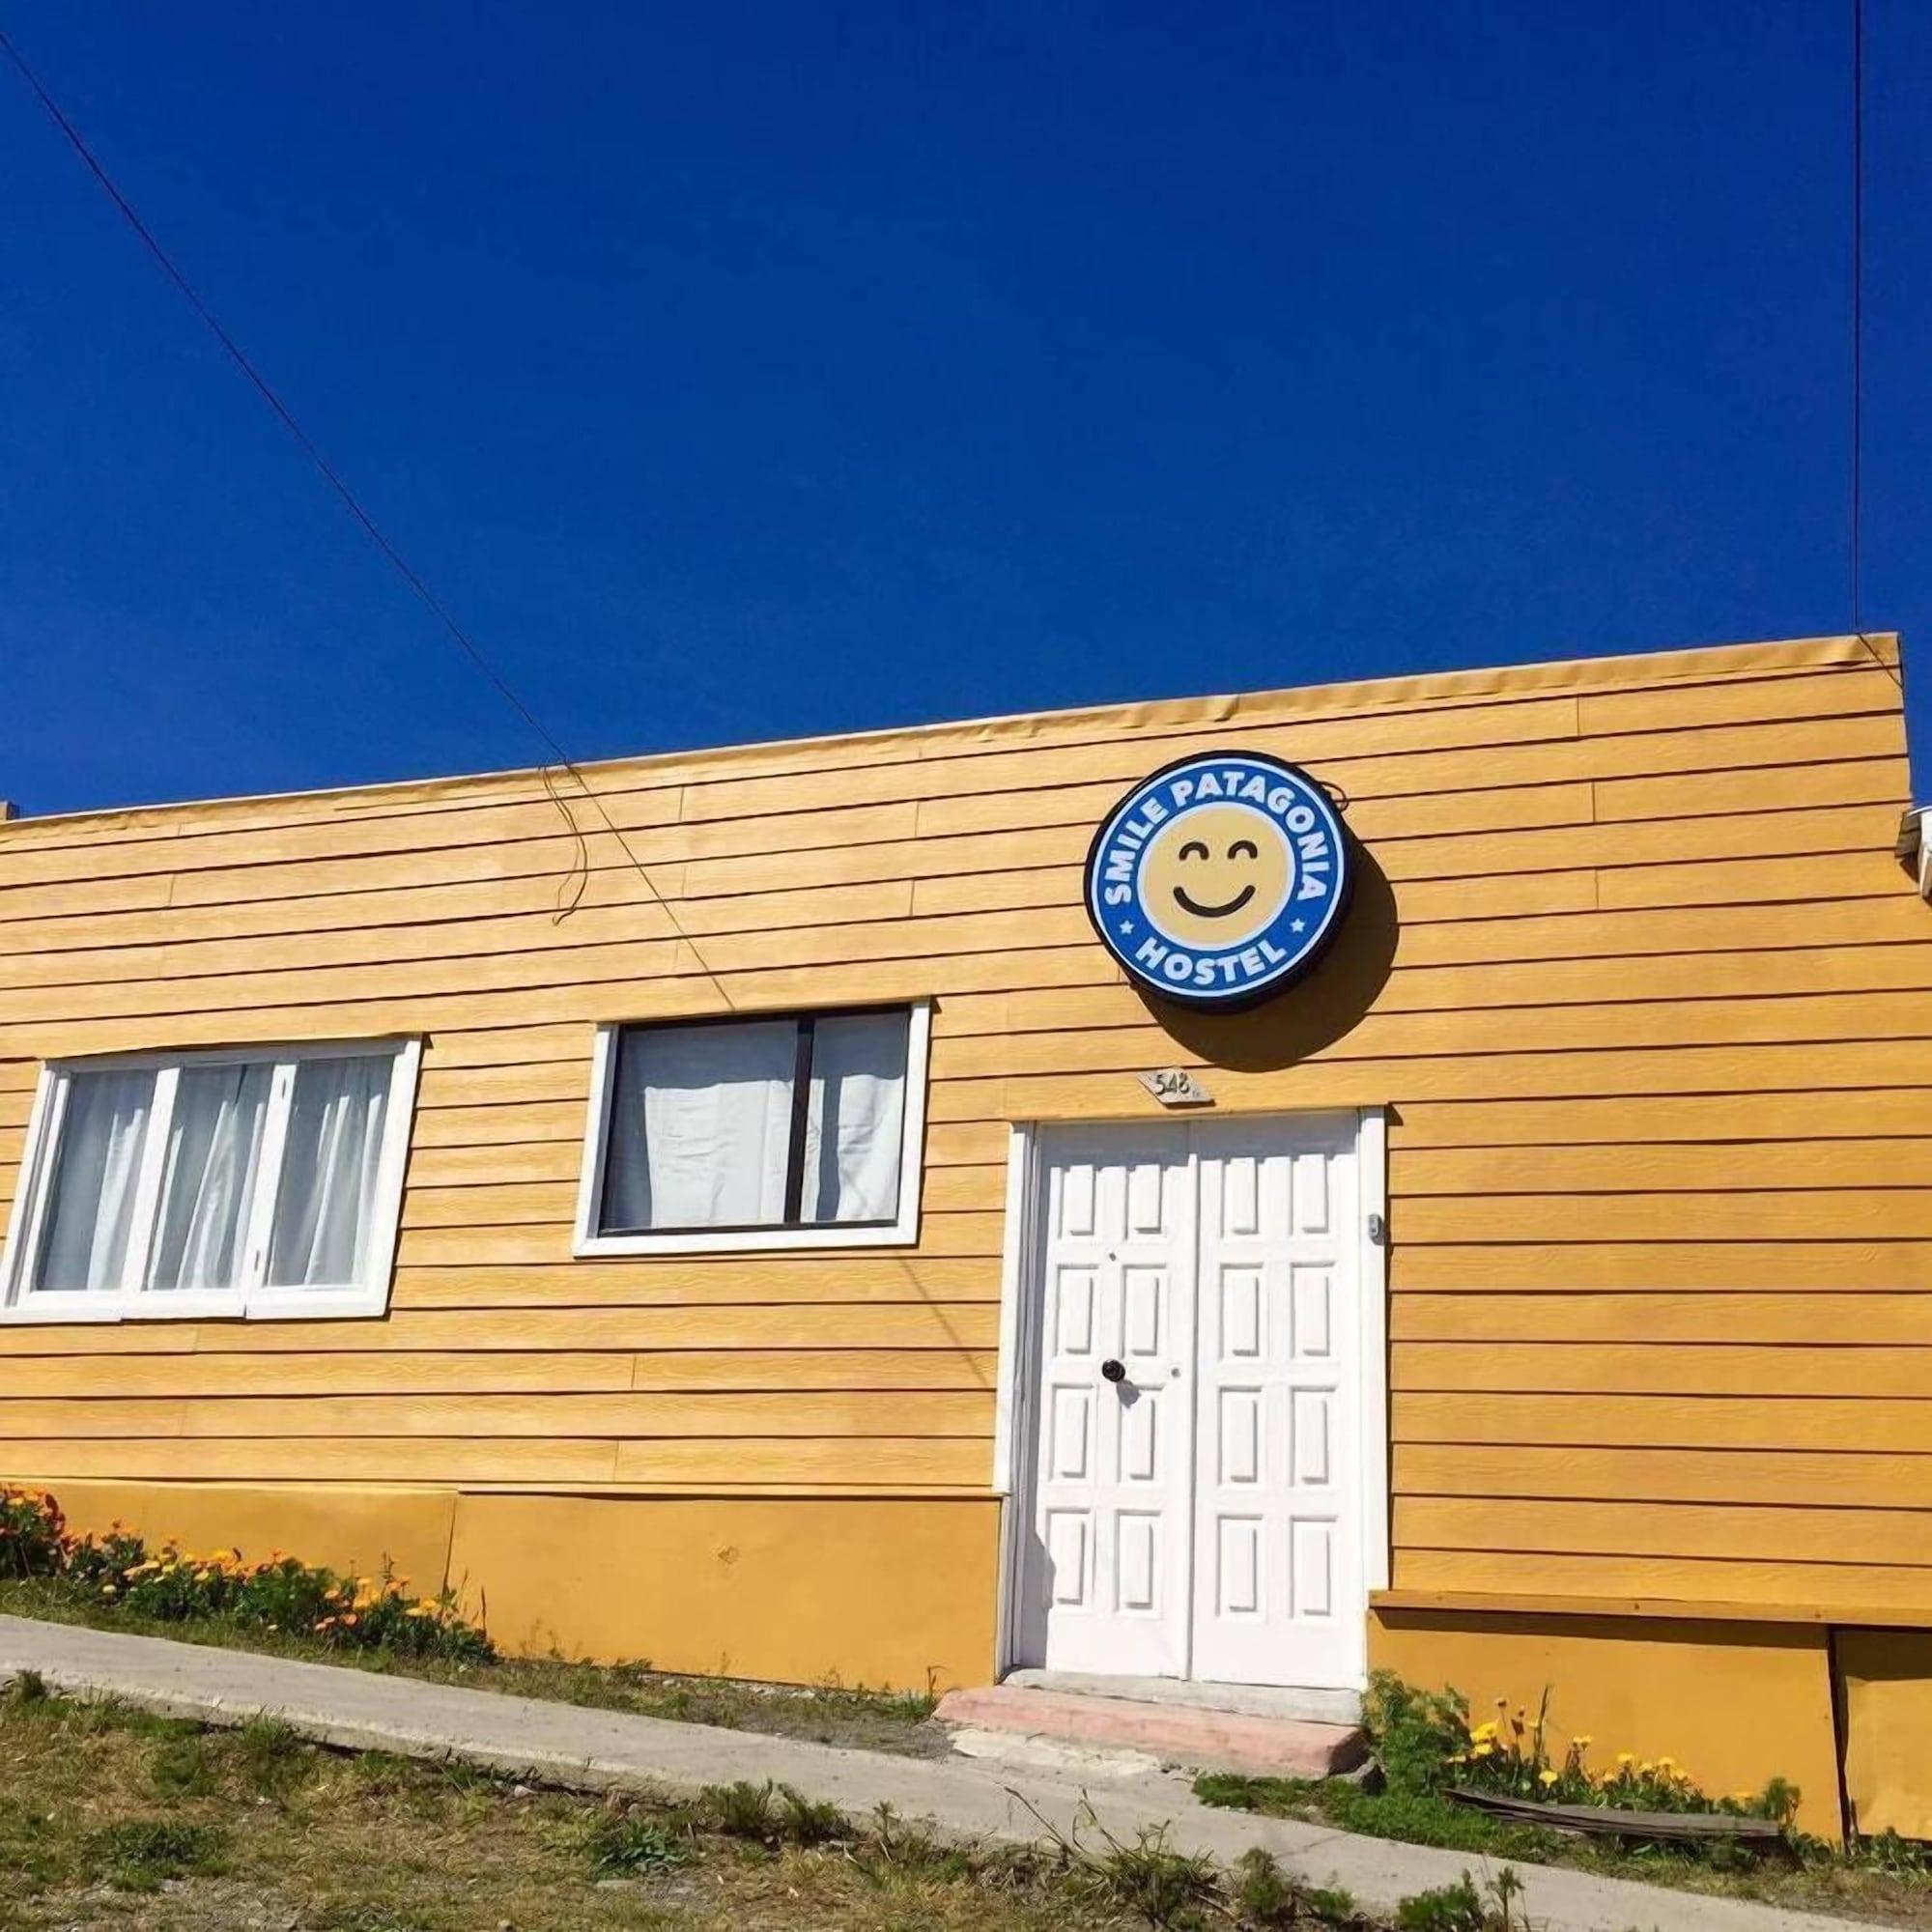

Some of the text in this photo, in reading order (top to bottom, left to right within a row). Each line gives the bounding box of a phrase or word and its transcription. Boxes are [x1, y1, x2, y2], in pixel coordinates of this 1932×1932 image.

[1104, 771, 1330, 906] SMILE PATAGONIA
[1135, 936, 1288, 985] HOSTEL
[1154, 1071, 1190, 1096] 548
